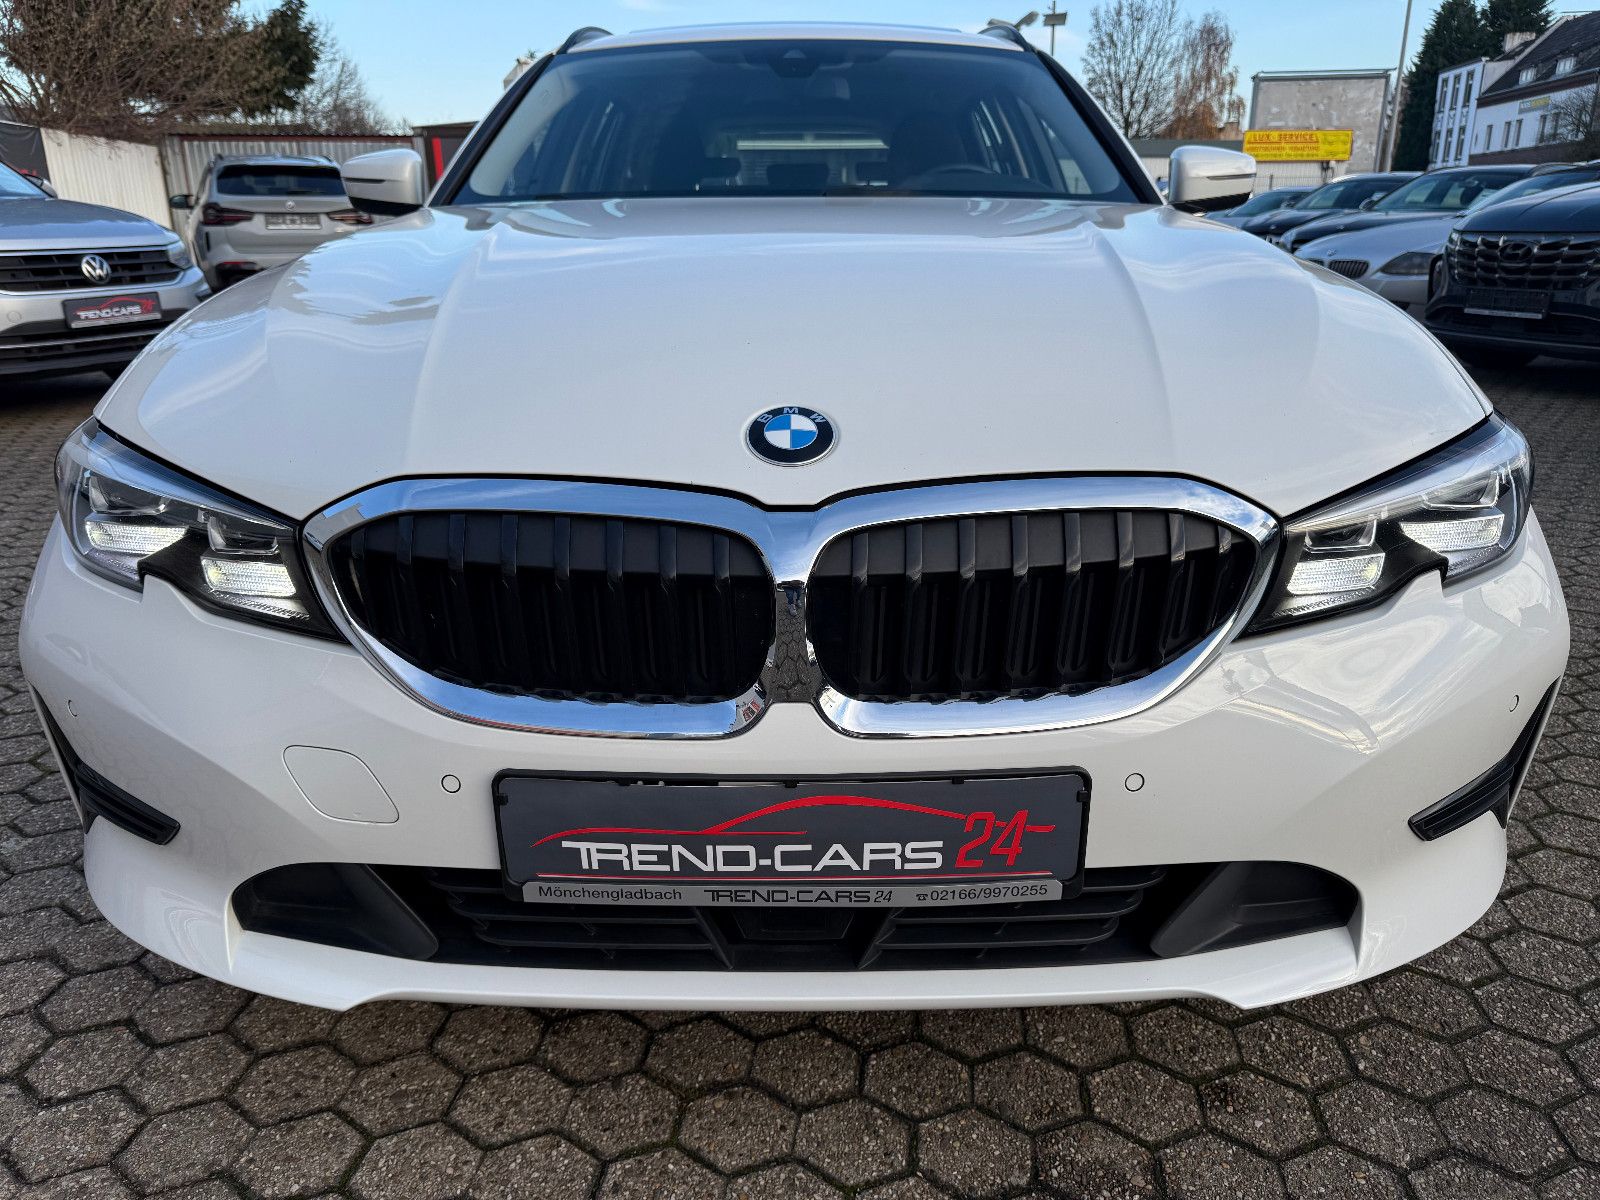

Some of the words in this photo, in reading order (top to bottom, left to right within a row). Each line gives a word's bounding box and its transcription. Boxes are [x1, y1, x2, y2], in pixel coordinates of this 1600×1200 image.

[1279, 132, 1315, 141] SERVICE
[757, 407, 827, 423] BMW
[561, 840, 944, 872] TREND-CARS
[954, 809, 1029, 868] 24
[537, 885, 683, 901] Mönchengladbach
[703, 889, 871, 904] TREND-CARS
[873, 890, 893, 903] 24
[929, 884, 1048, 902] 02166/9970255
